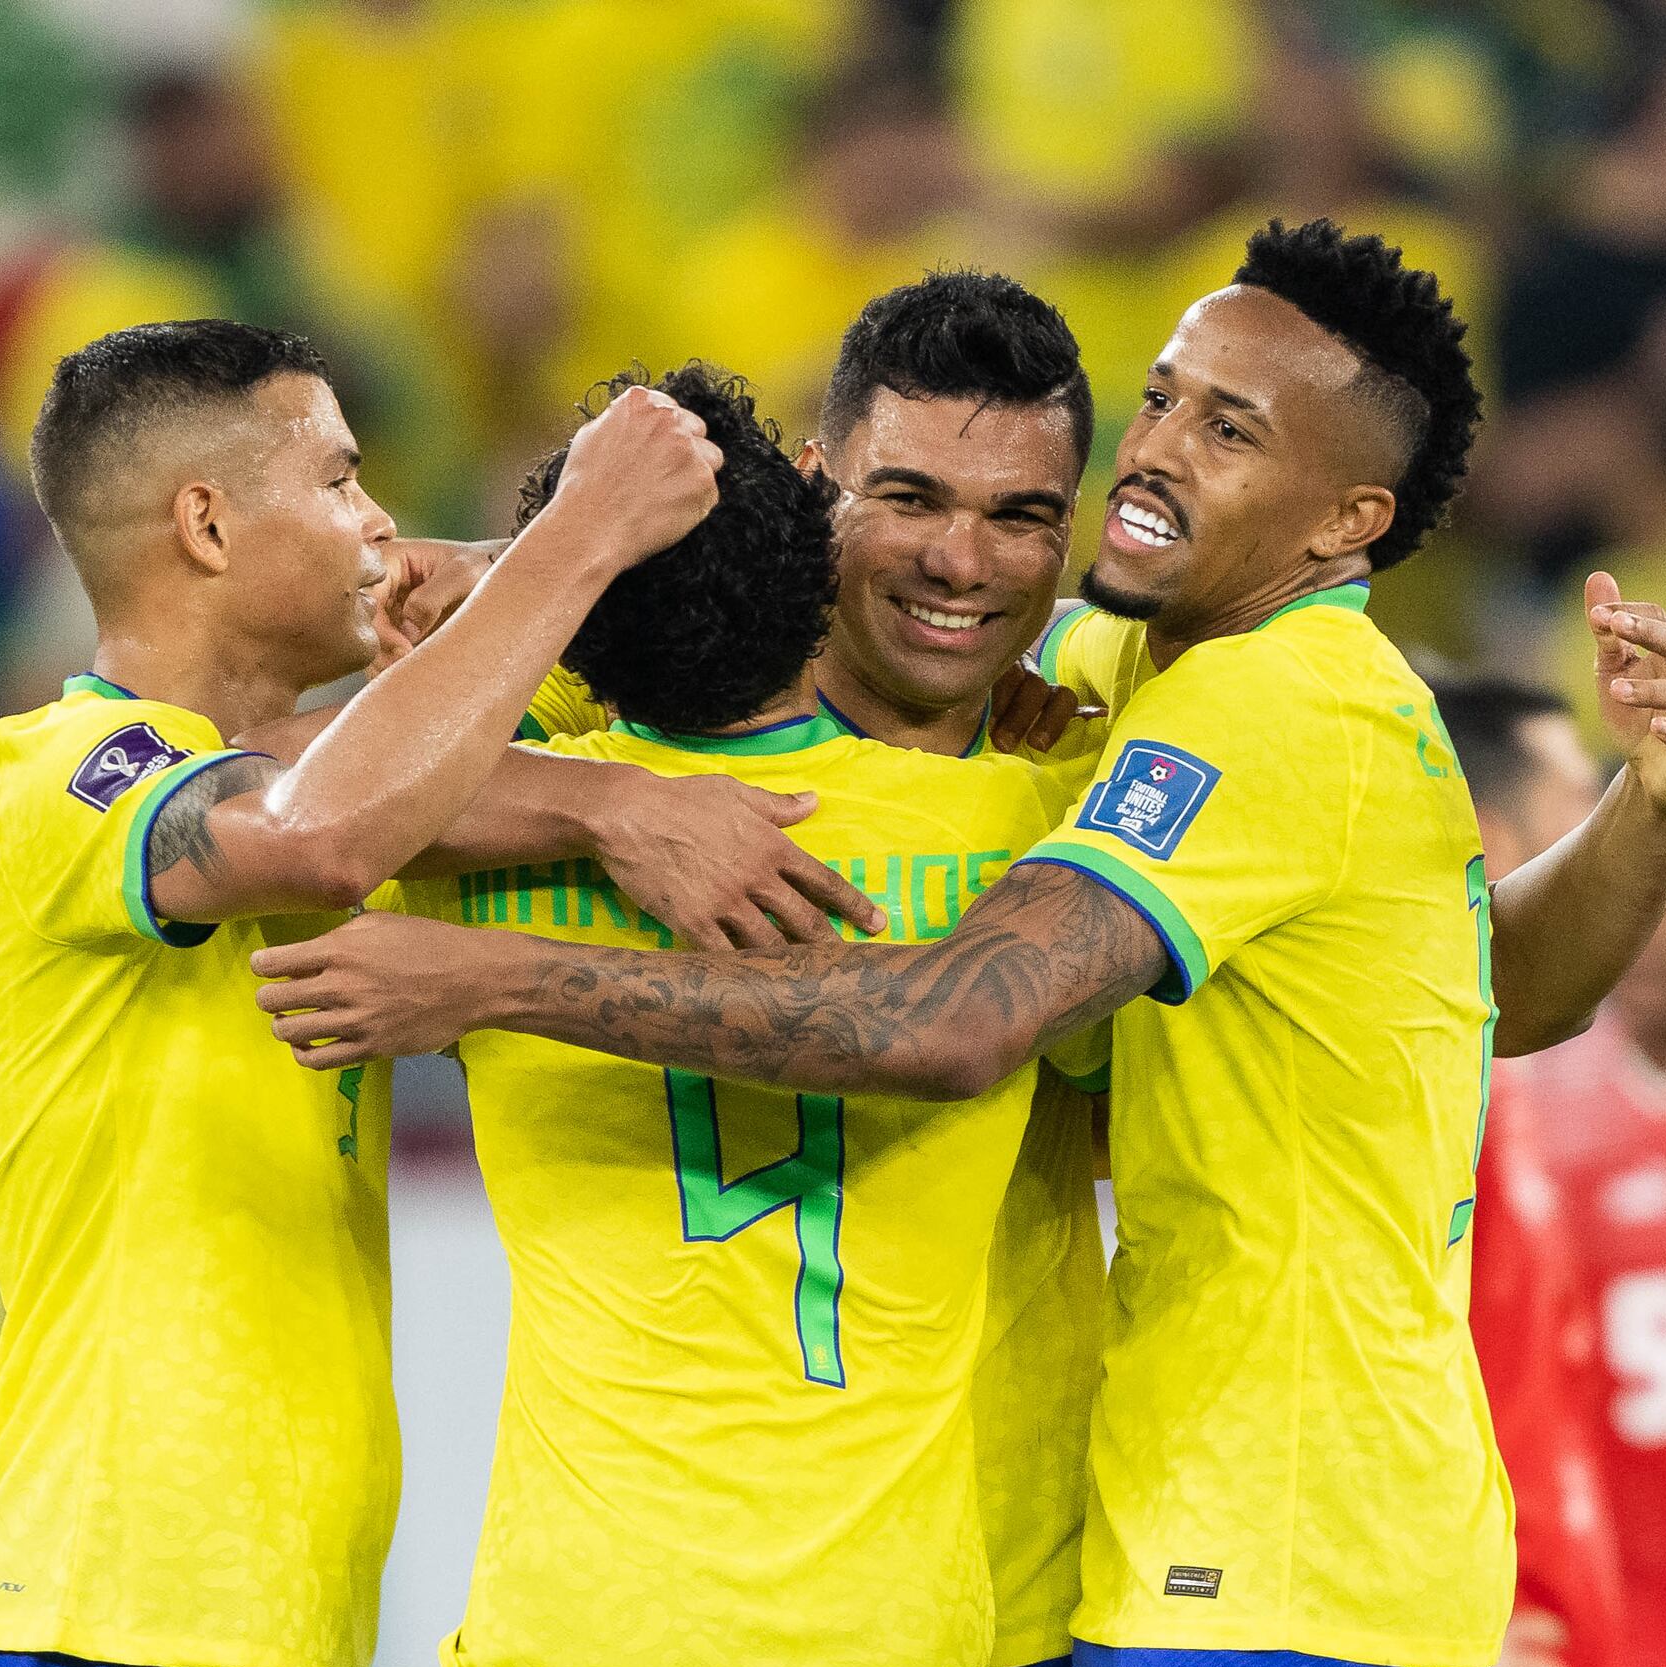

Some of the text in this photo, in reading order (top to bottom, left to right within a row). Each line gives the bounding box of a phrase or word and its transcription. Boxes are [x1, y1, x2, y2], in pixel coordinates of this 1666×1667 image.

[1123, 789, 1165, 815] UNITES
[1131, 779, 1168, 804] FOOTBALL
[664, 1066, 846, 1389] 4
